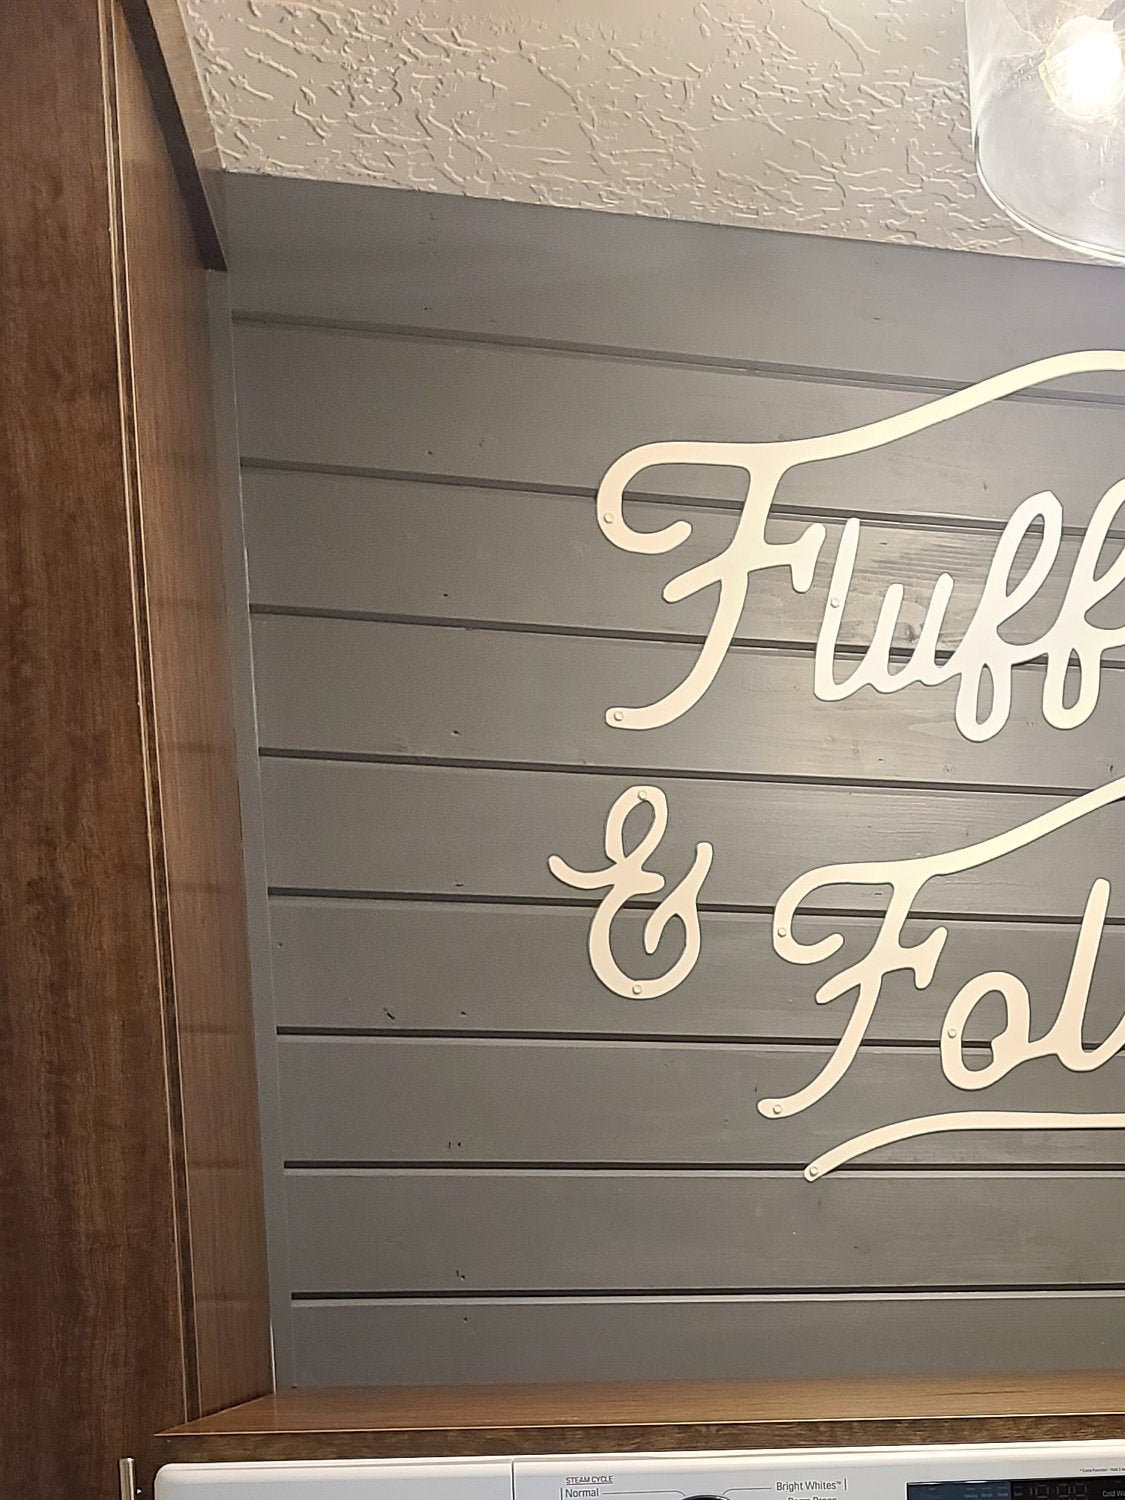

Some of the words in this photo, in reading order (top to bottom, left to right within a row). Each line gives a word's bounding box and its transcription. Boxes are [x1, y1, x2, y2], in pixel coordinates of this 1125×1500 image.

[548, 785, 713, 1000] &
[566, 1476, 590, 1484] STEAM
[591, 1475, 613, 1484] CYCLE
[776, 1481, 803, 1492] Bright
[565, 1487, 599, 1498] Normal
